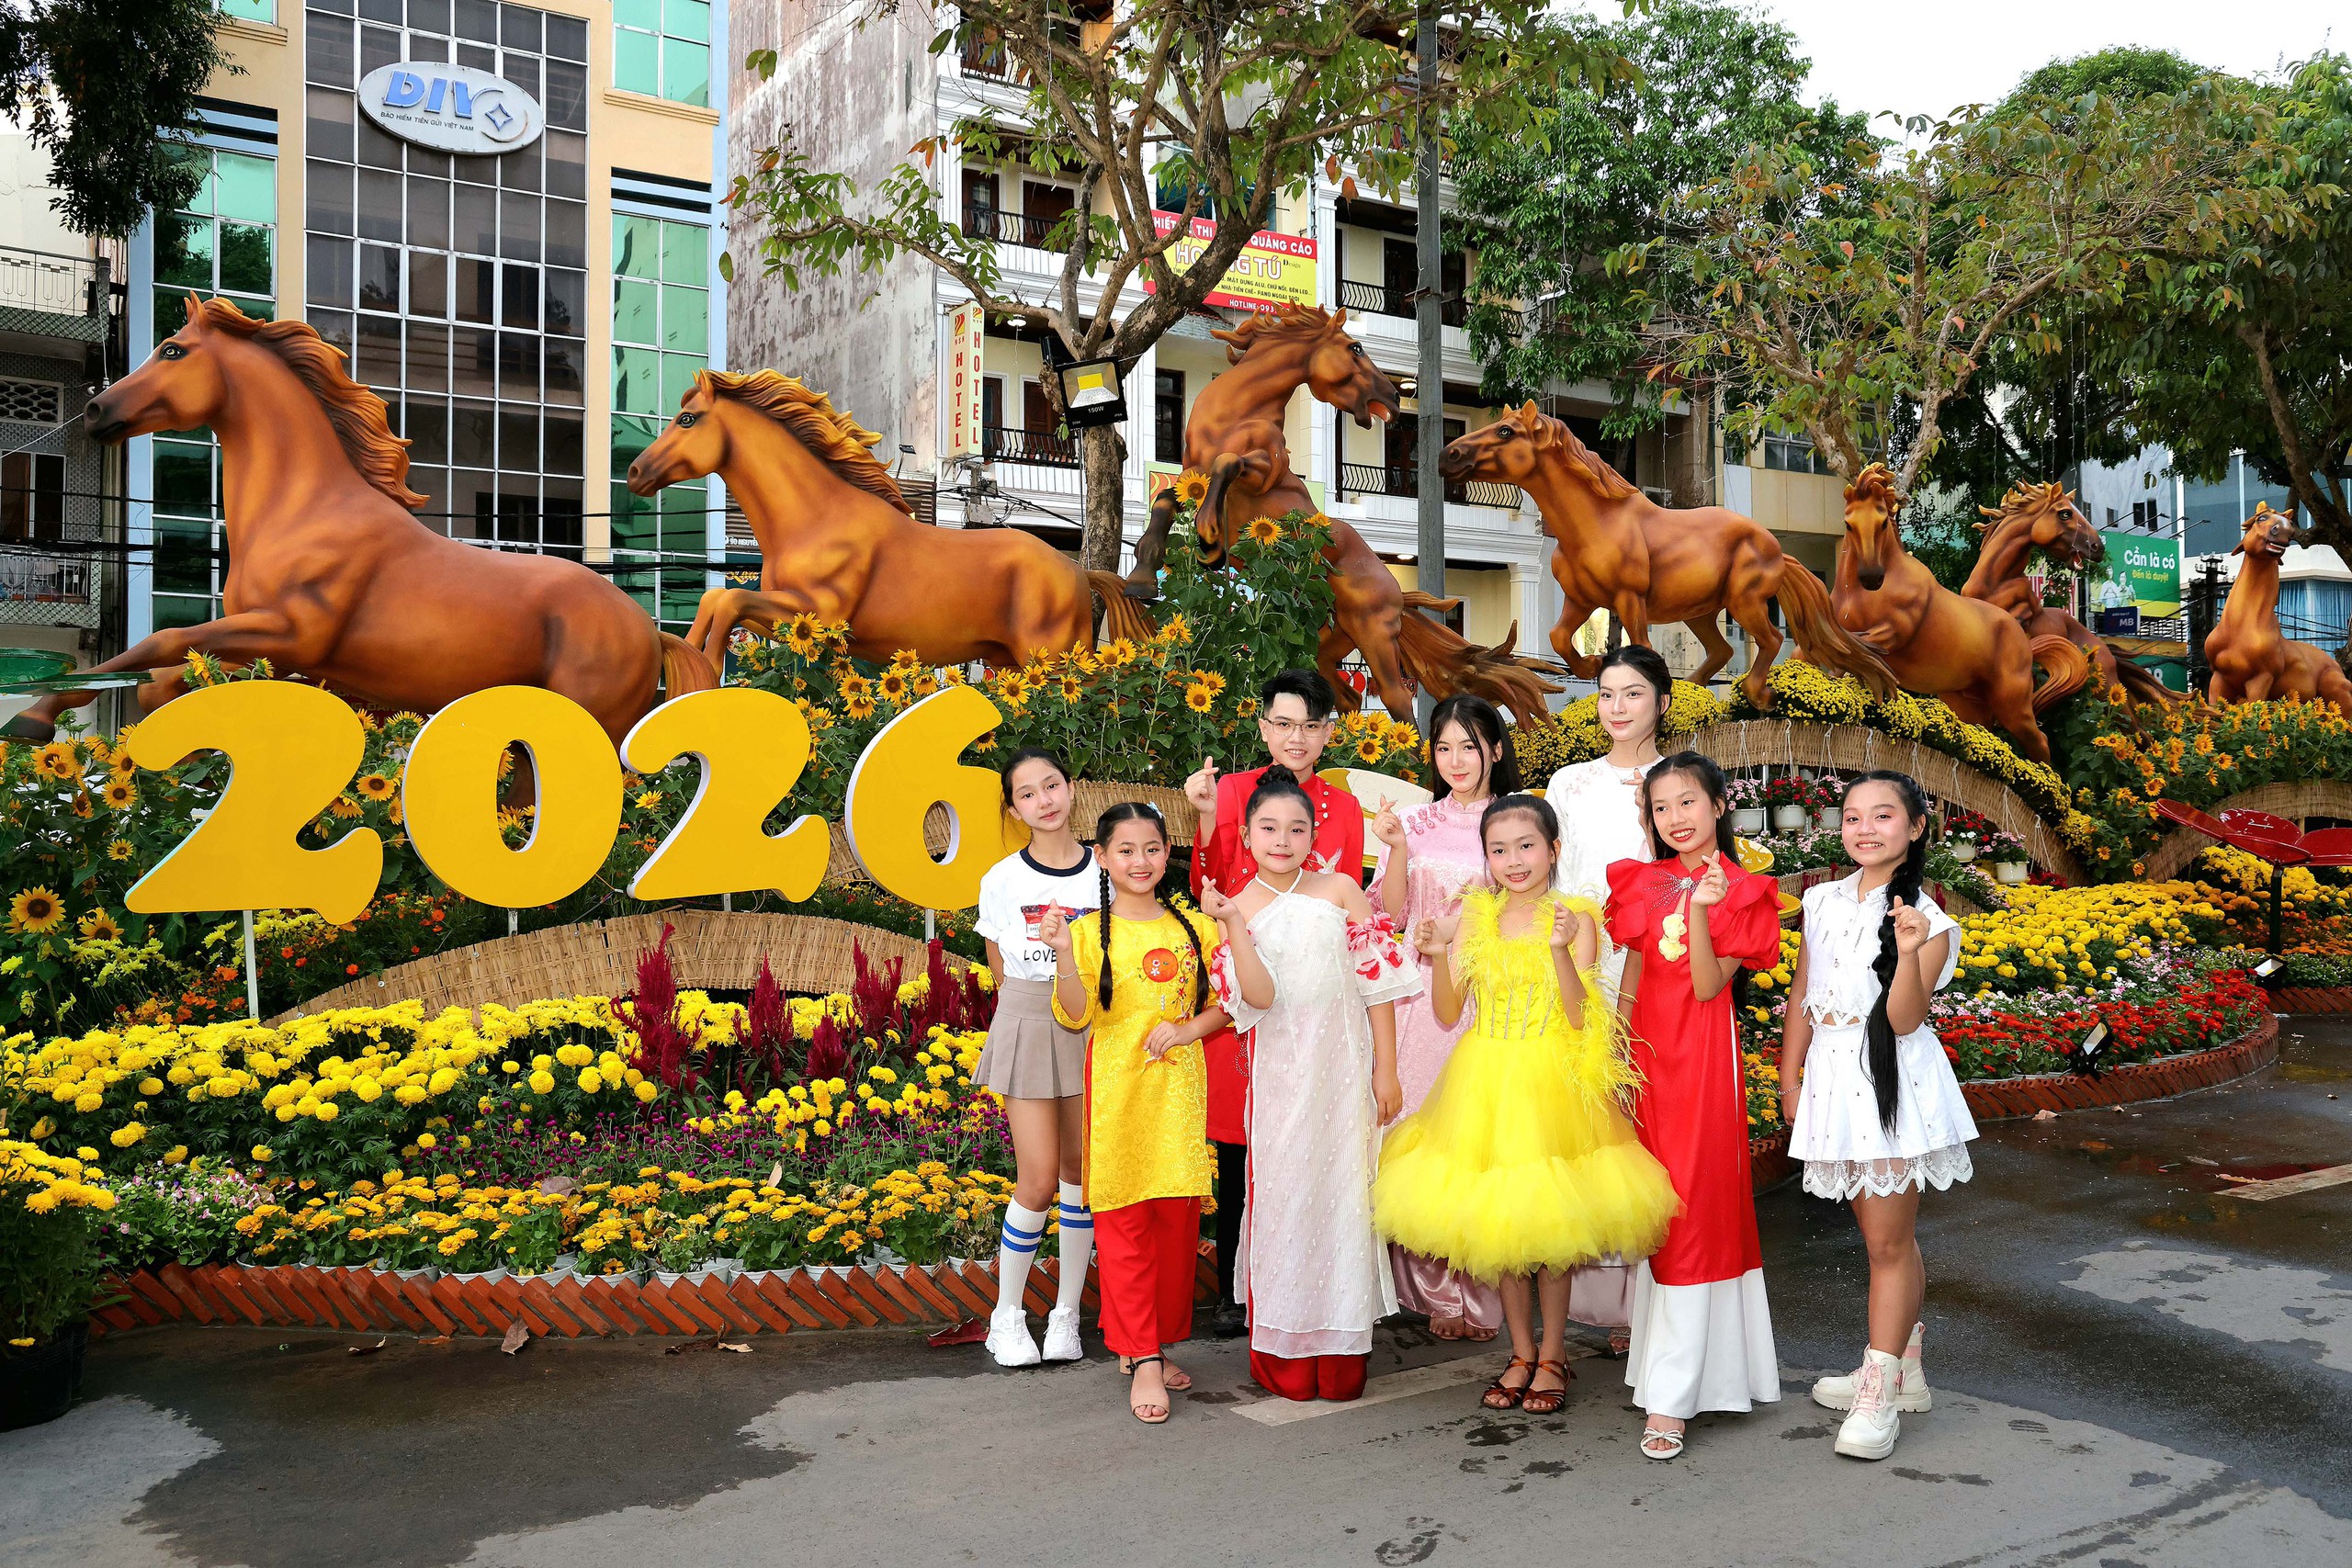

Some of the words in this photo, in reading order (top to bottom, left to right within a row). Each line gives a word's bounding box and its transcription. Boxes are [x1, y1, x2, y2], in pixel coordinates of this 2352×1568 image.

[1152, 215, 1177, 231] HIẾT
[1195, 224, 1213, 238] THI
[1250, 234, 1287, 251] QUẢNG
[1290, 241, 1313, 256] CÁO
[1252, 254, 1282, 280] TÚ
[955, 351, 963, 448] HOTEL
[973, 331, 981, 445] HOTEL
[2123, 545, 2147, 567] Cần
[2149, 551, 2160, 568] là
[2162, 553, 2176, 570] có
[2119, 617, 2134, 626] MB
[123, 680, 1027, 926] 2026
